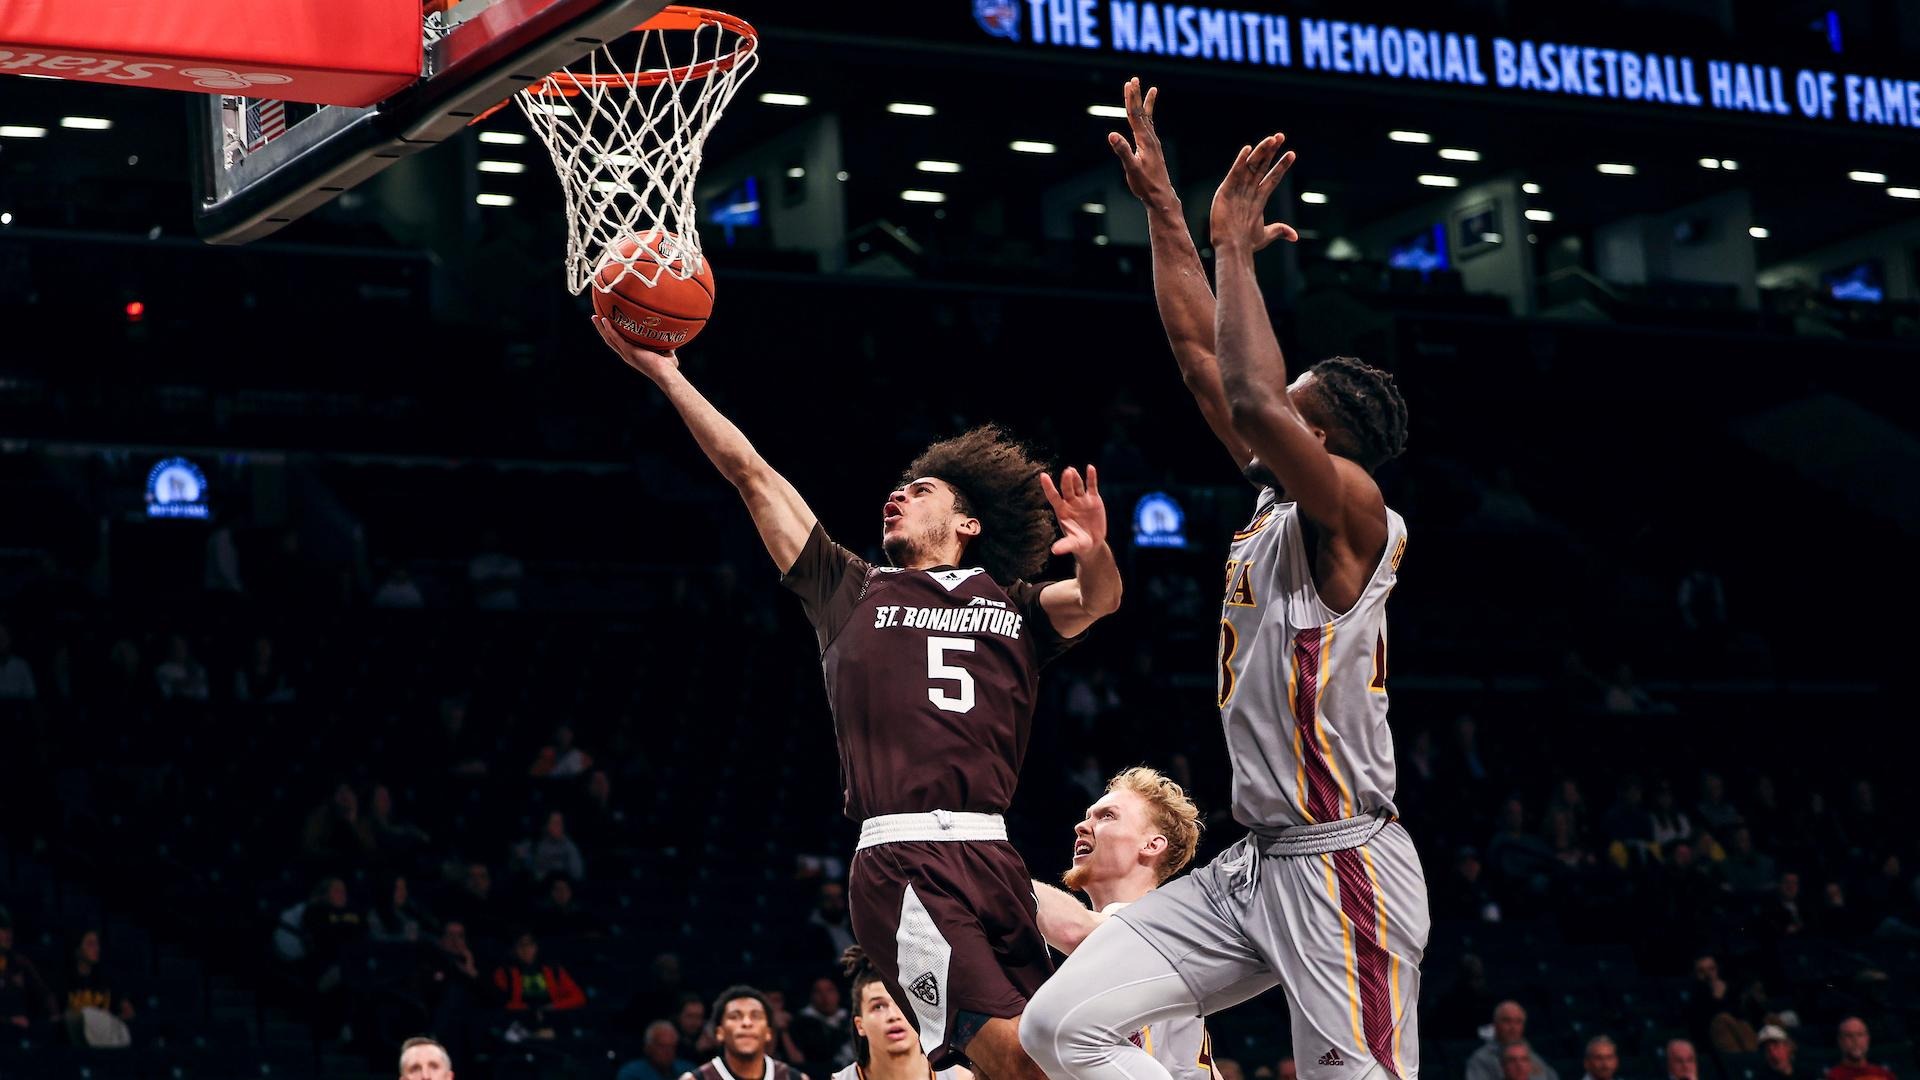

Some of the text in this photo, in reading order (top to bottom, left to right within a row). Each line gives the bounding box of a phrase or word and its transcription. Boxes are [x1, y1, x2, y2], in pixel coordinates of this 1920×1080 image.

[1029, 0, 1920, 128] THE NAISMITH MEMORIAL BASKETBALL HALL OF FAME
[874, 606, 1023, 640] ST. BONAVENTURE
[927, 636, 975, 714] 5
